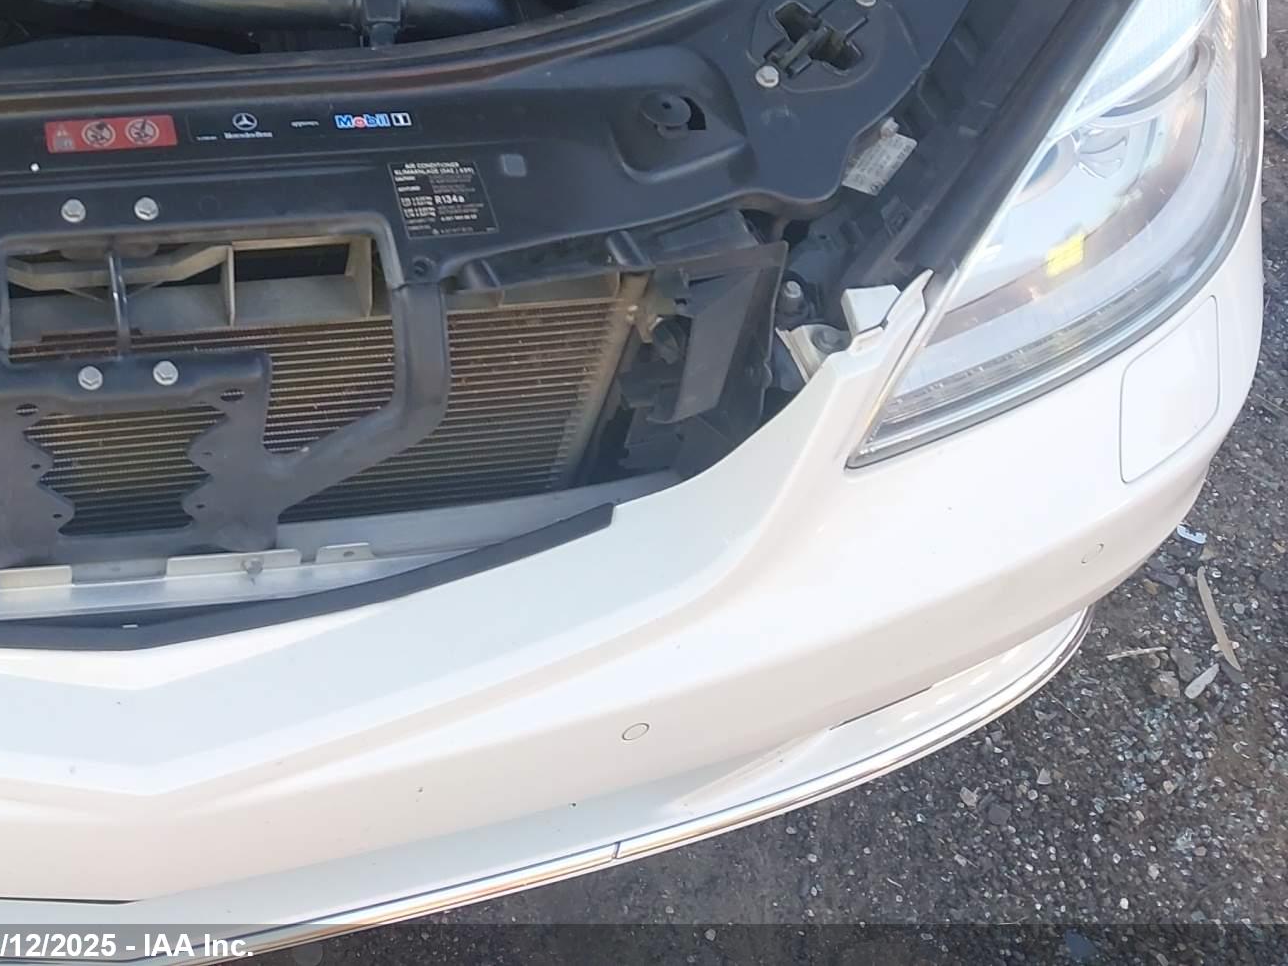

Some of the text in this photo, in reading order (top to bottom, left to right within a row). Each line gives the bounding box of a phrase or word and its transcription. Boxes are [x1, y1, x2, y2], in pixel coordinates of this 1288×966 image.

[334, 114, 391, 129] Mobil
[392, 113, 412, 126] 1
[434, 194, 465, 204] R134a
